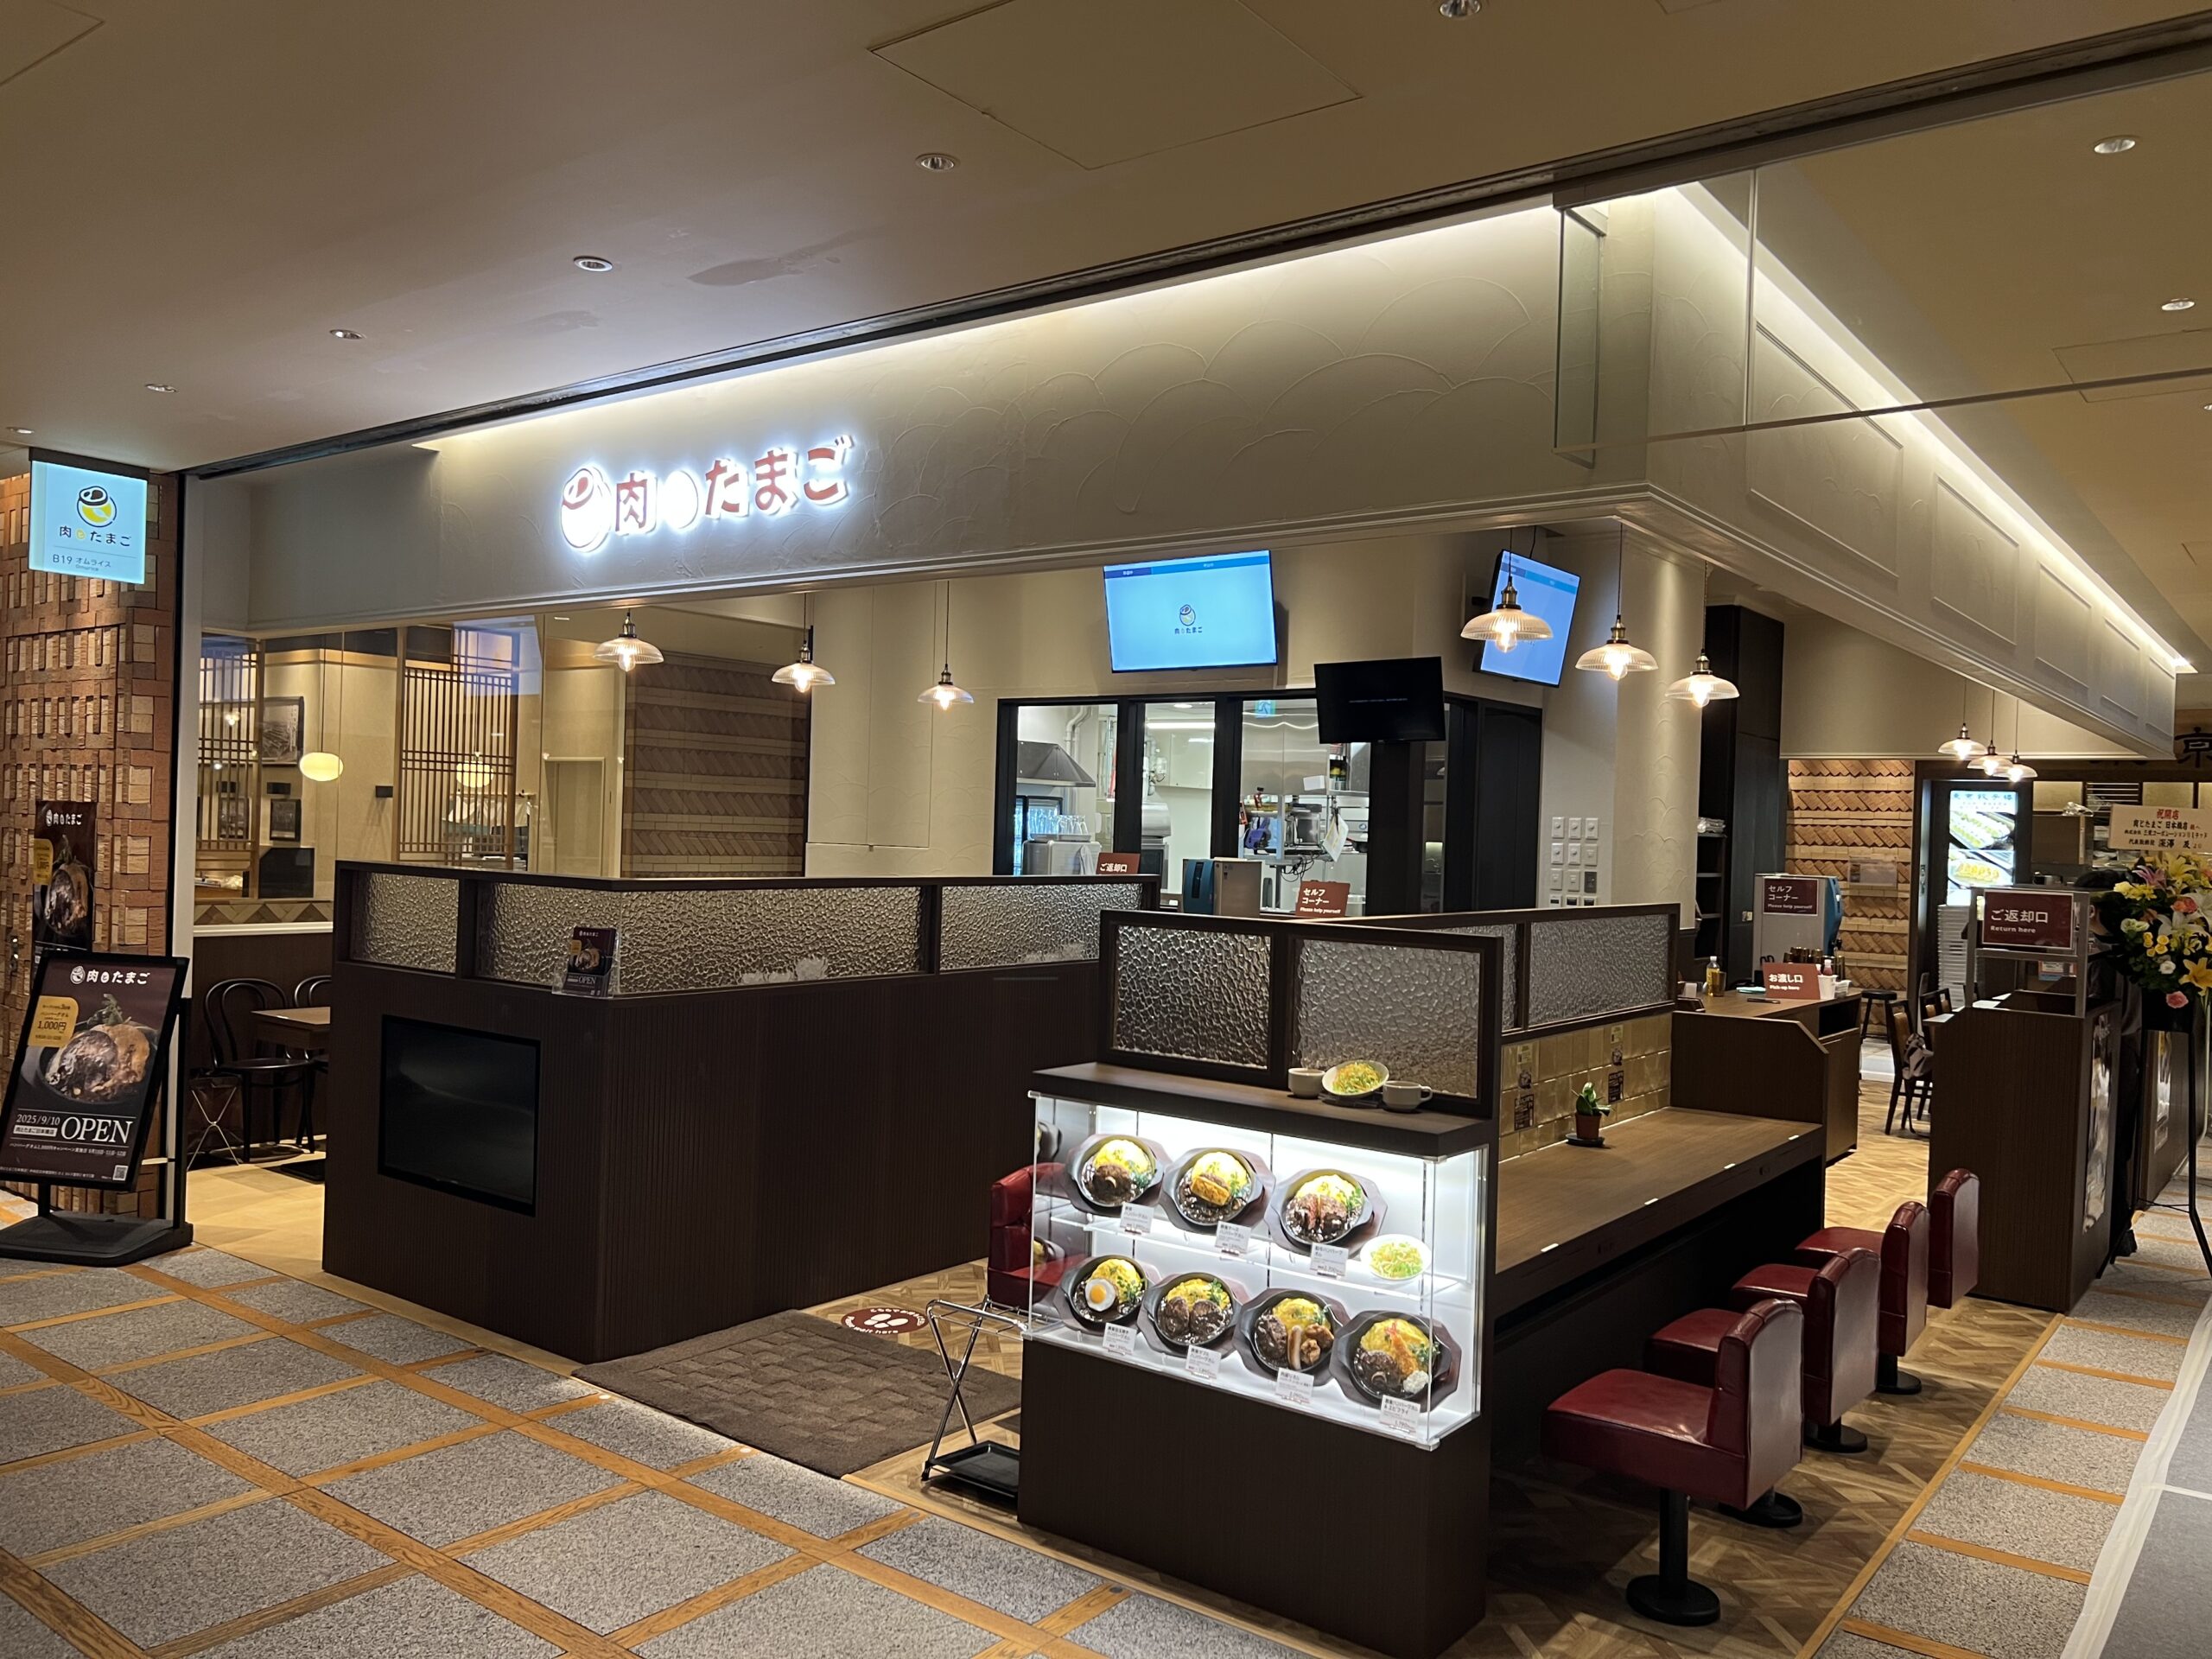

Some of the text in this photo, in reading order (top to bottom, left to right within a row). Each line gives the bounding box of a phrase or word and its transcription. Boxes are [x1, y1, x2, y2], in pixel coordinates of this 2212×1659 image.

[615, 435, 851, 533] 肉たまご
[53, 554, 111, 568] B19 オムライス
[1100, 862, 1128, 873] ご返却口
[1303, 887, 1325, 897] セルフ
[1768, 885, 1793, 893] セルフ
[1301, 897, 1330, 906] コーナー
[1991, 908, 2049, 924] ご返却口
[1769, 973, 1803, 983] お渡し口
[16, 1114, 133, 1144] 2025/9/10 OPEN
